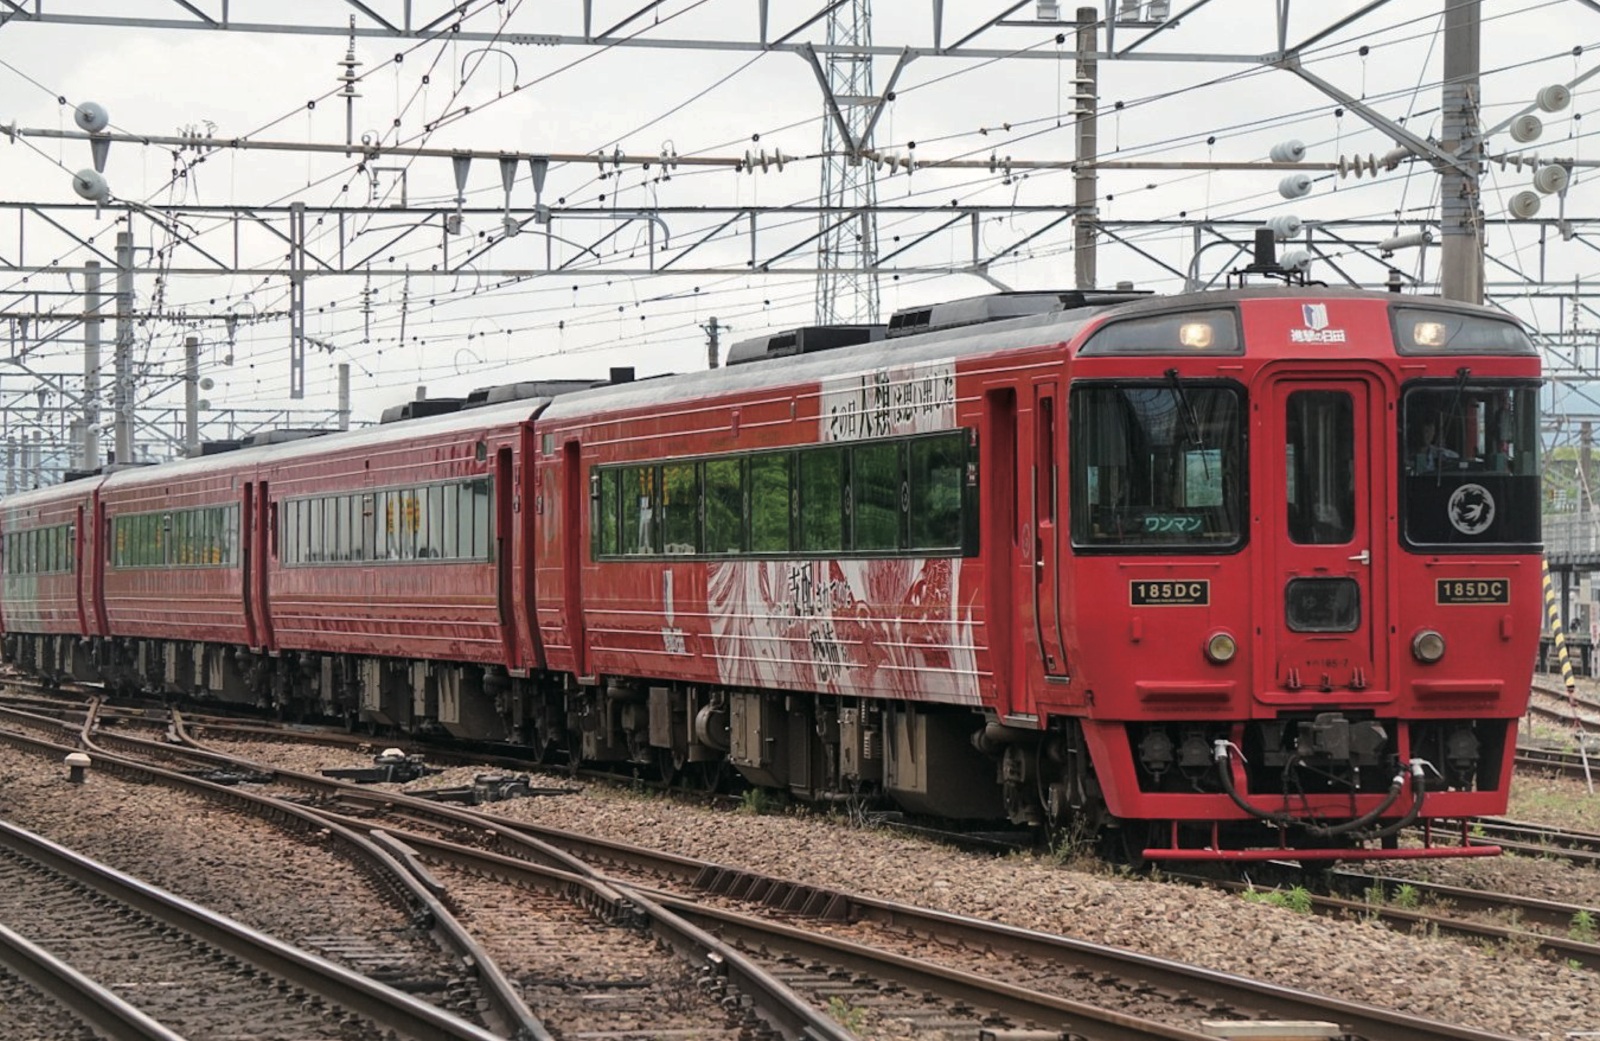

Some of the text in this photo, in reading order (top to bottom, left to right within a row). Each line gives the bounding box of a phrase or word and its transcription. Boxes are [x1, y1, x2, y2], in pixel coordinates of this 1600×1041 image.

[1145, 517, 1202, 532] ワンマン
[1138, 584, 1202, 598] 185DC
[1443, 582, 1503, 596] 185DC
